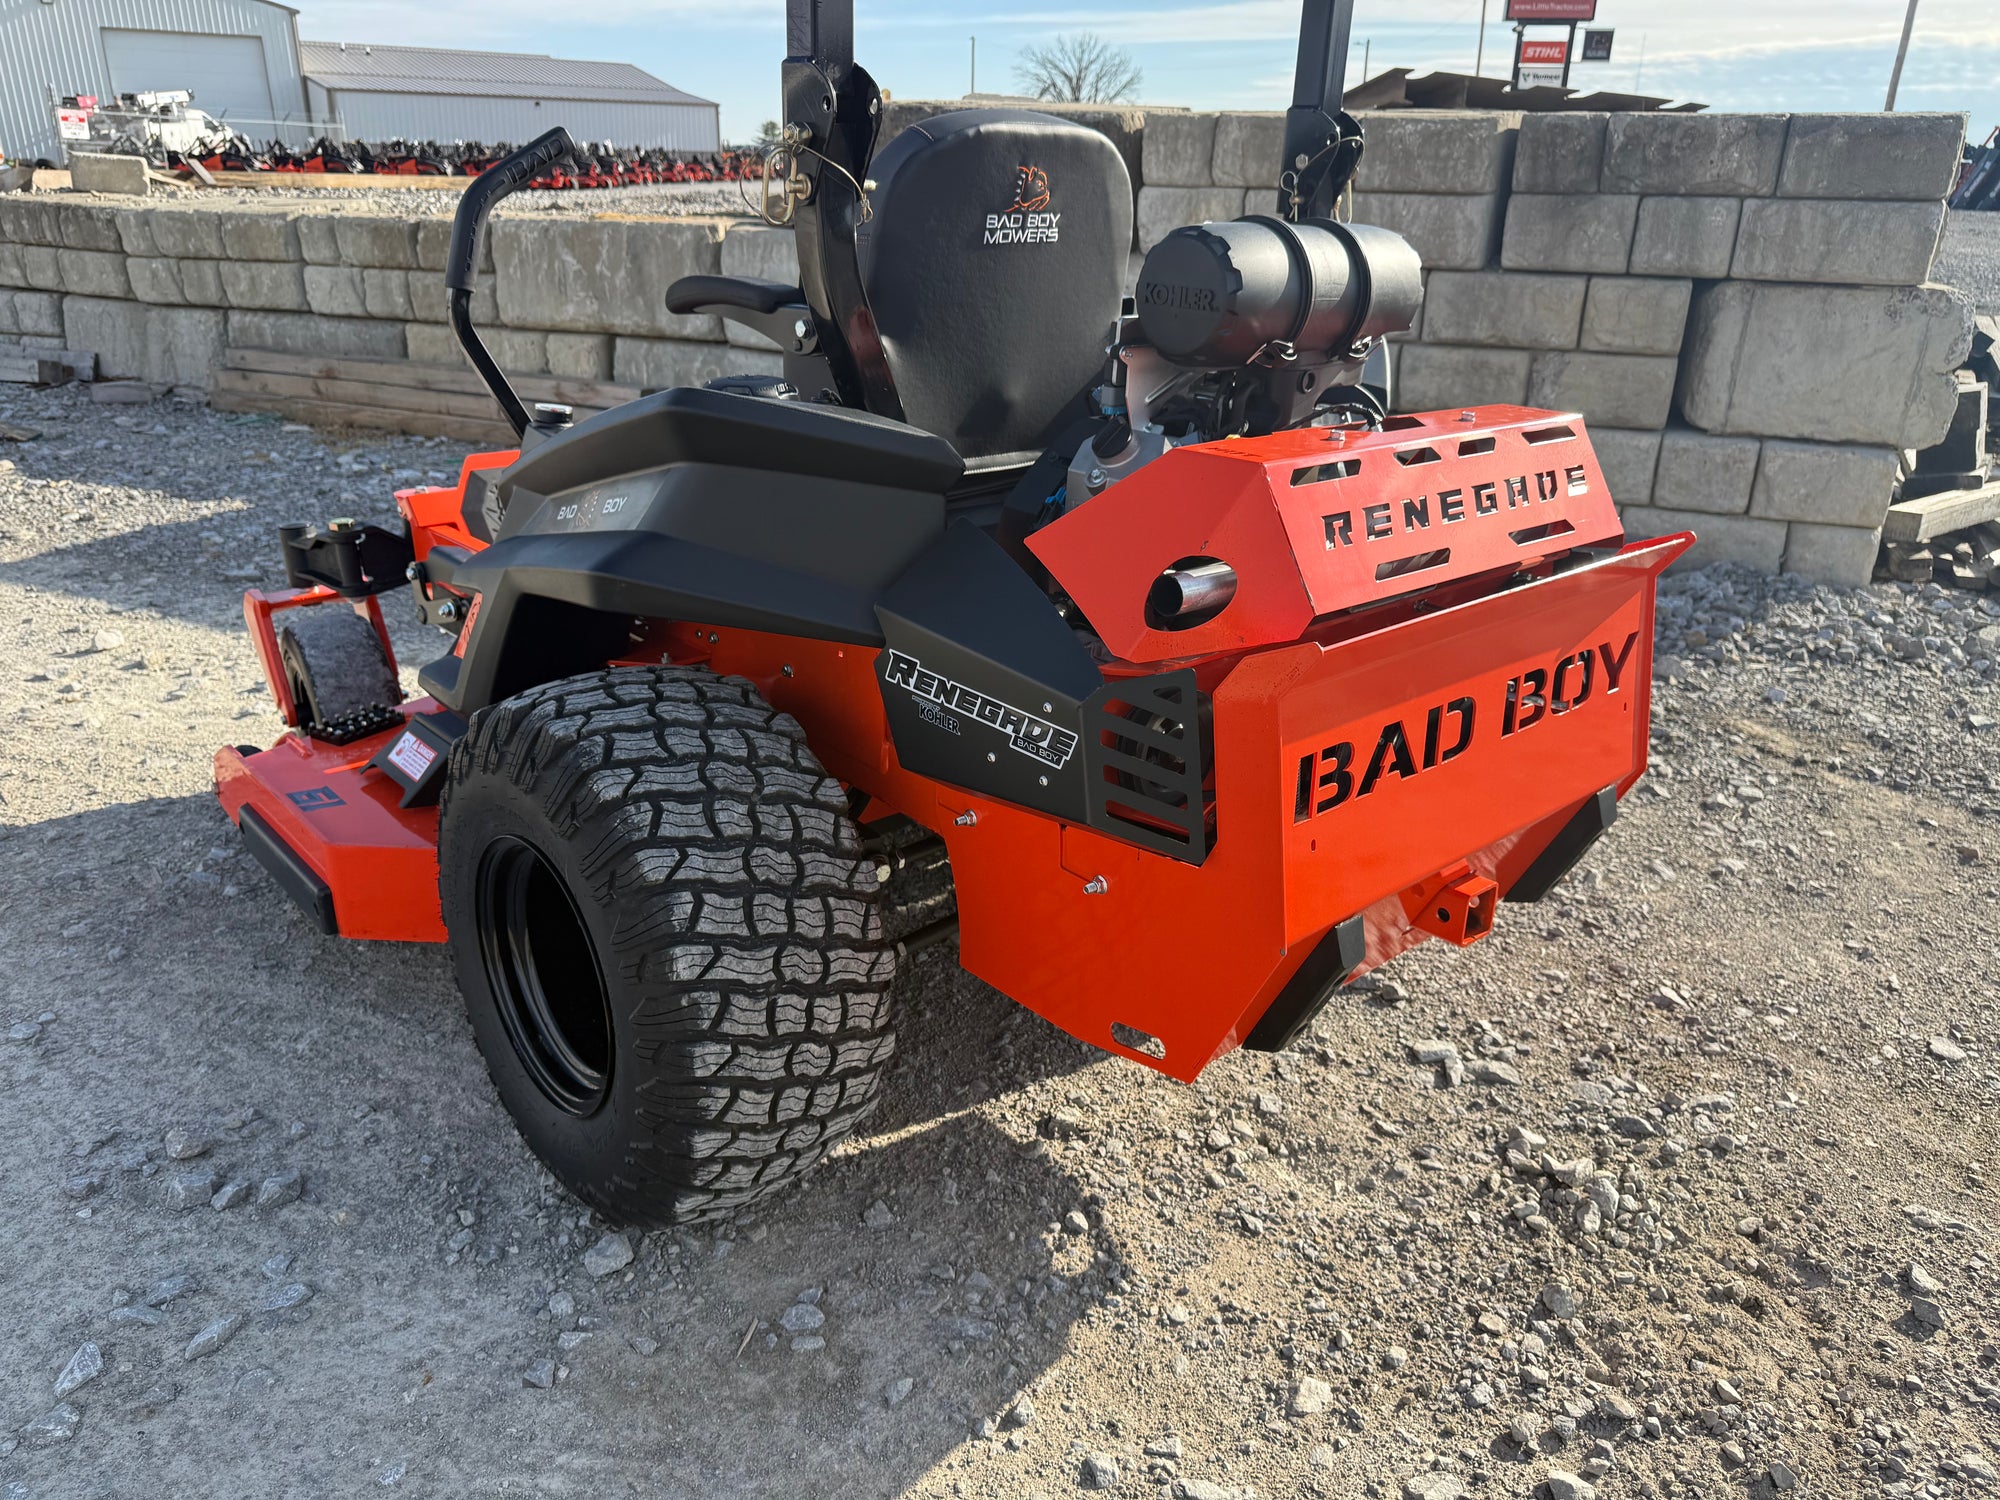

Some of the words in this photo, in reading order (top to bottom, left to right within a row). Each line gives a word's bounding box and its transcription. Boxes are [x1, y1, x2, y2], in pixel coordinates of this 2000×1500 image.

[1525, 47, 1562, 58] STIHL
[505, 138, 564, 185] BAD
[986, 214, 1022, 229] BAD
[1027, 212, 1060, 228] BOY
[983, 228, 1059, 244] MOWERS
[1144, 282, 1214, 312] KOHLER
[557, 504, 577, 520] BAD
[602, 496, 628, 513] BOY
[1321, 464, 1587, 550] RENEGADE
[885, 648, 1079, 761] RENEGADE
[919, 703, 961, 735] KOHLER
[1293, 696, 1477, 825] BAD
[1501, 631, 1639, 739] BOY
[1017, 739, 1037, 753] BAD
[1039, 748, 1059, 762] BOY
